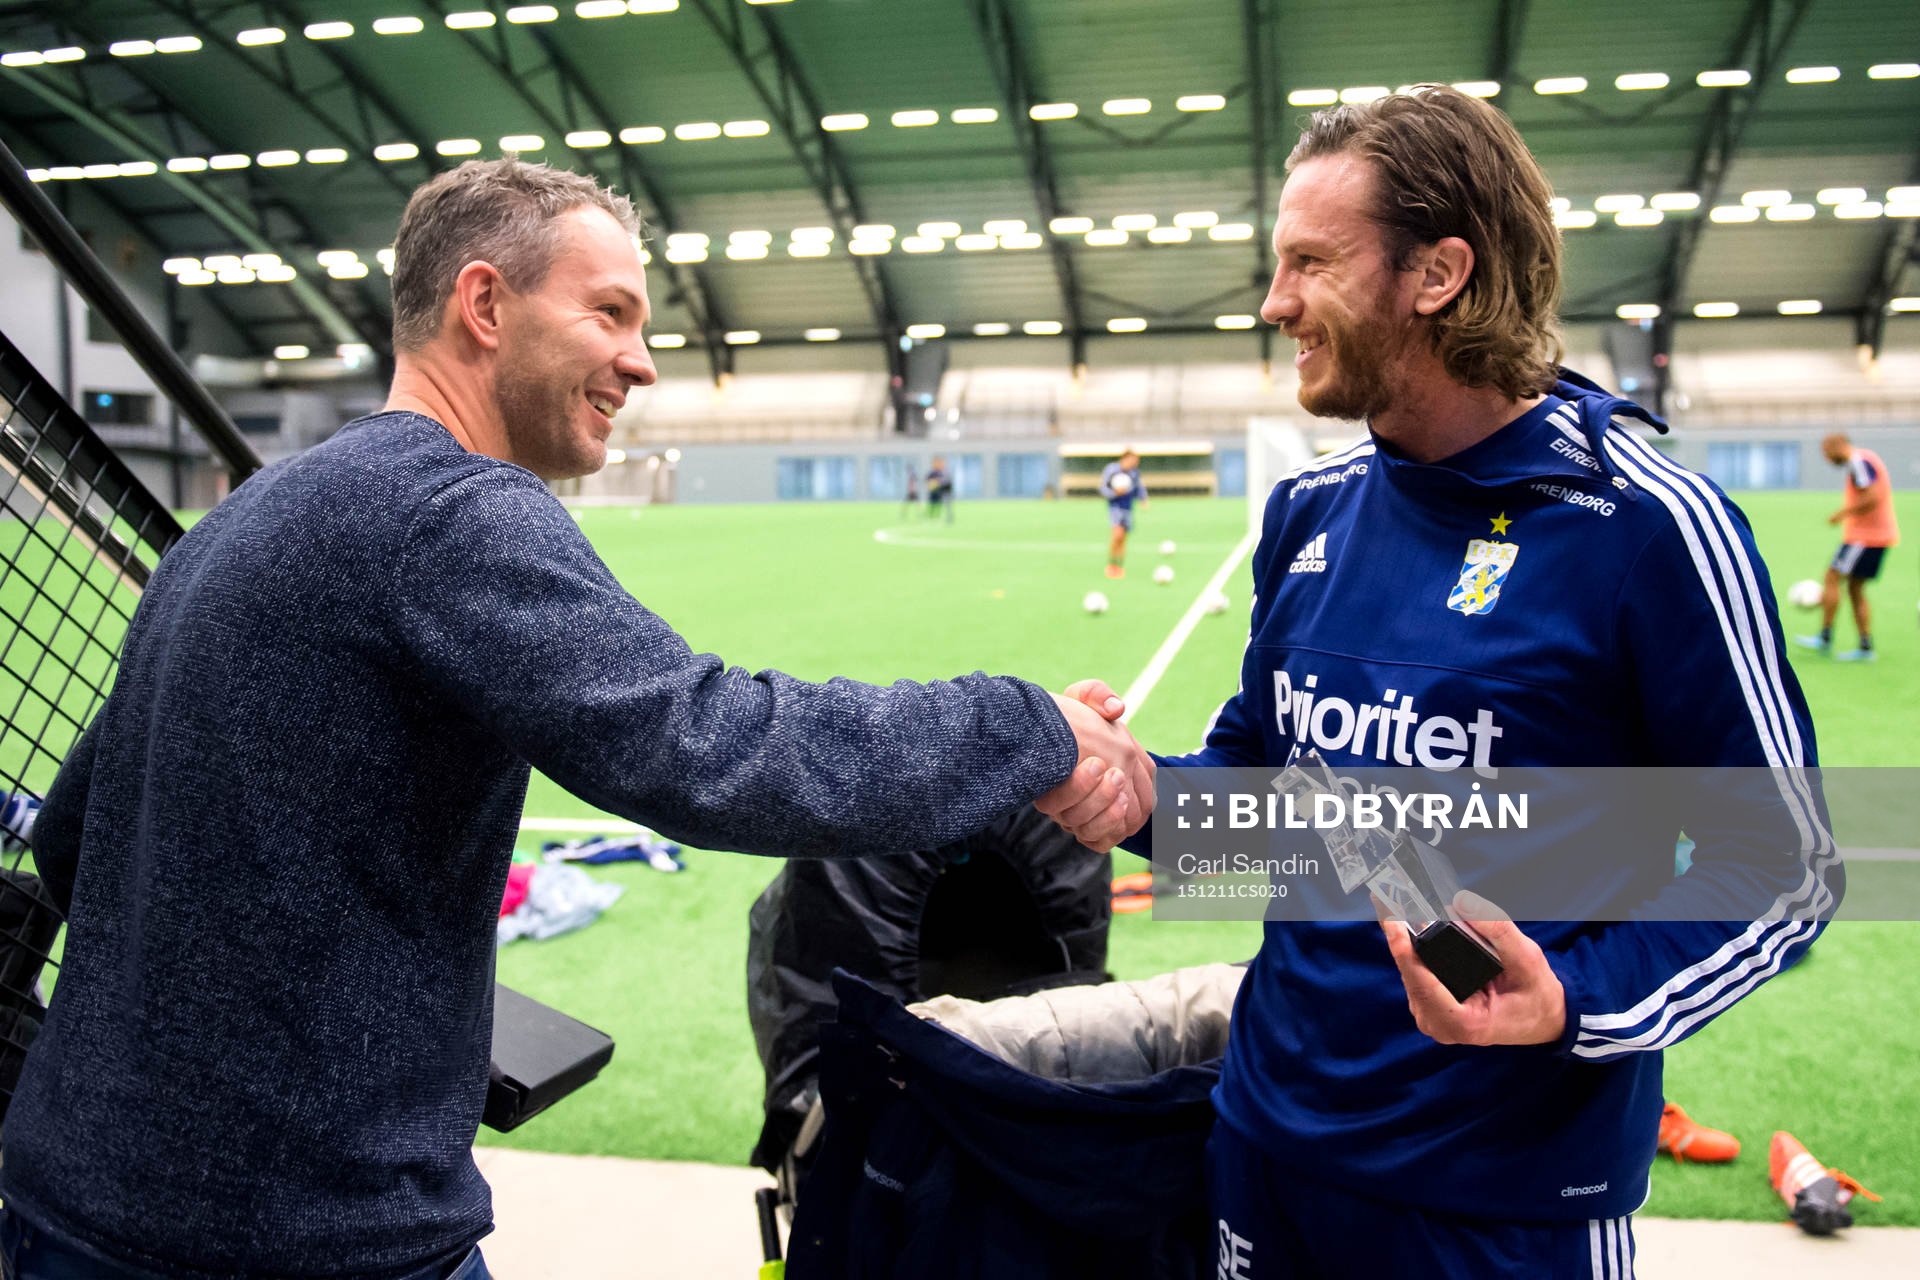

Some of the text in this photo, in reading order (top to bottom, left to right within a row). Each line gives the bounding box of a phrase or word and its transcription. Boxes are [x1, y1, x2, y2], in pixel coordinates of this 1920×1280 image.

[1530, 483, 1616, 517] RENBORG
[1288, 557, 1328, 574] adidas
[1273, 670, 1503, 780] Prioritet
[1560, 1180, 1608, 1197] climacool
